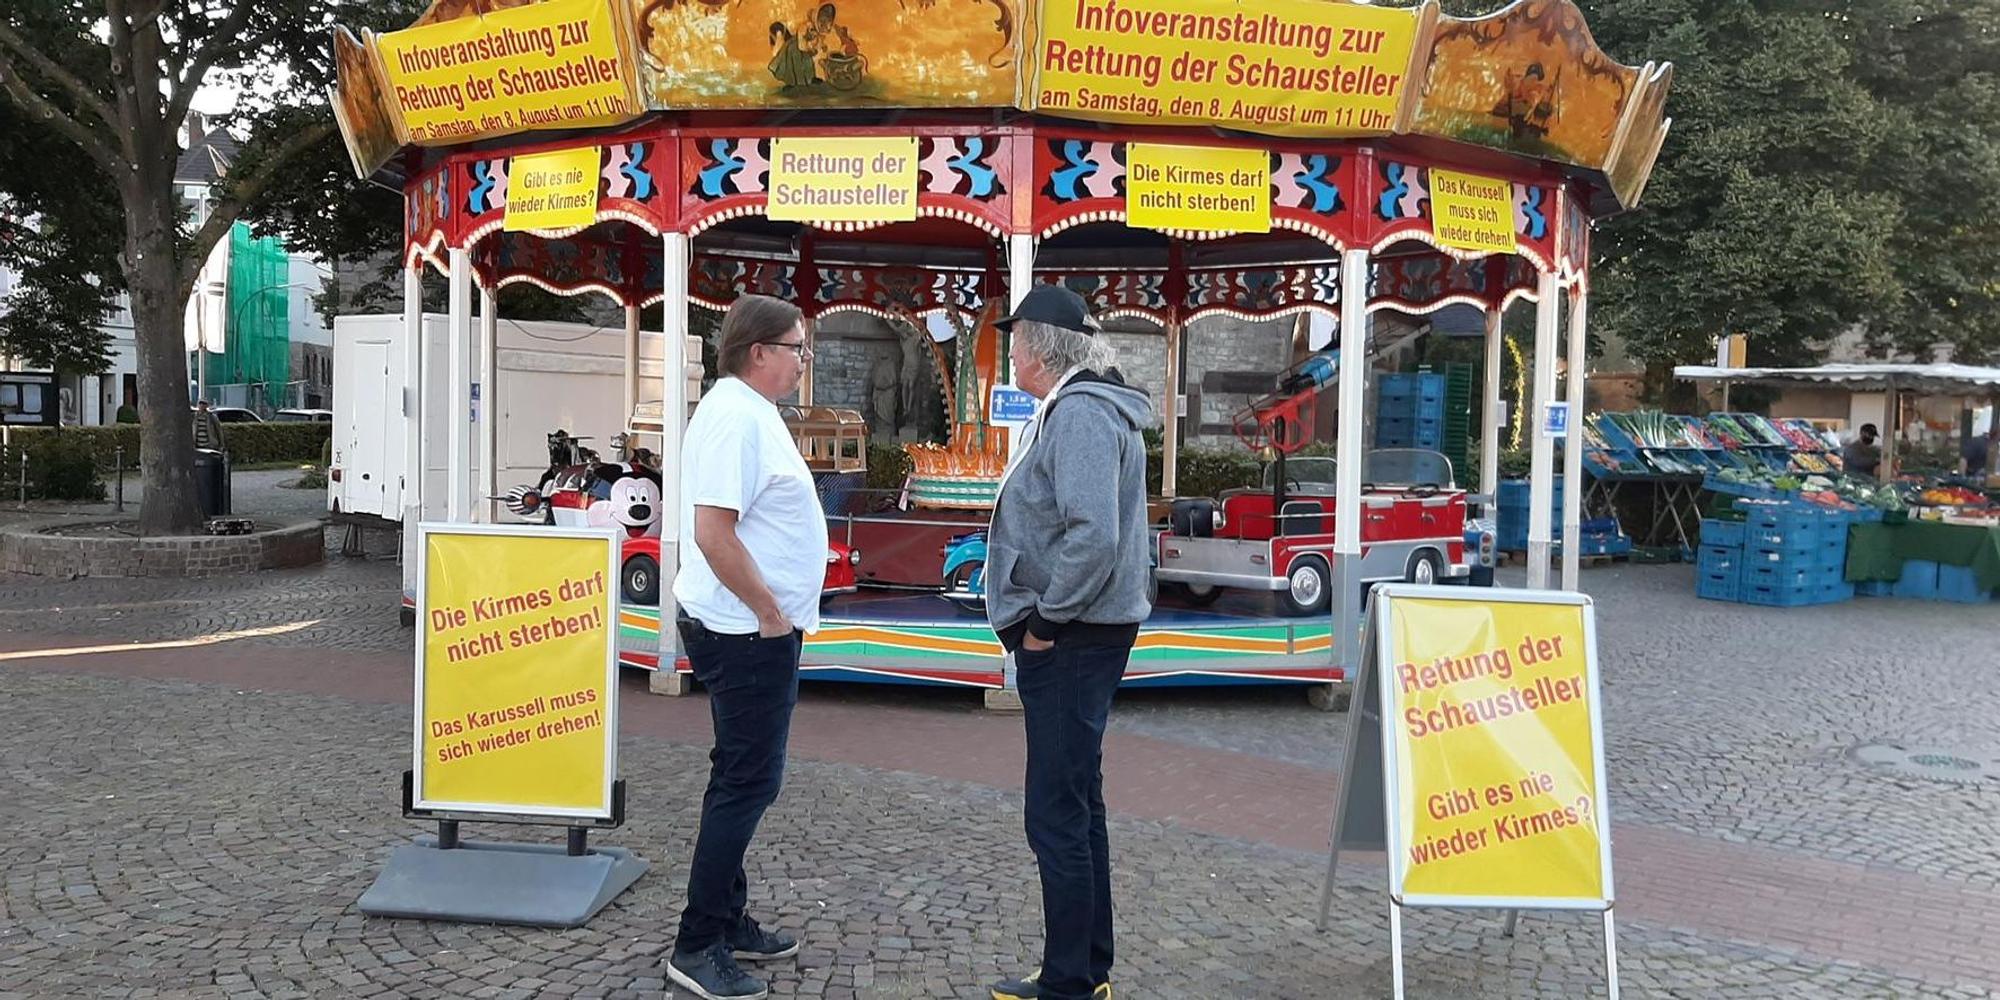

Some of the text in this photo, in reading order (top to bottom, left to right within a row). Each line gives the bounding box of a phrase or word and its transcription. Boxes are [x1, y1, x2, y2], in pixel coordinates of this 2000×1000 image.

[397, 19, 590, 74] Infoveranstaltung zur
[1075, 0, 1386, 58] Infoveranstaltung zur
[397, 56, 619, 112] Rettung der Schausteller
[1044, 40, 1401, 97] Rettung der Schausteller
[410, 127, 427, 140] am
[481, 113, 502, 130] den
[504, 112, 519, 127] 8.
[520, 107, 562, 124] August
[564, 105, 585, 118] um
[587, 98, 602, 116] 11
[1041, 88, 1392, 129] am Samstag, den 8. August um 11 Uhr
[524, 167, 583, 188] Gibt es nie
[782, 152, 906, 178] Rettung der
[1133, 164, 1263, 187] Die Kirmes darf
[1437, 176, 1505, 201] Das Karussell
[509, 190, 594, 213] wieder Kirmes?
[776, 184, 909, 205] Schausteller
[1140, 191, 1255, 212] nicht sterben!
[1449, 205, 1498, 223] muss sich
[1440, 224, 1511, 247] wieder drehen!
[431, 571, 604, 632] Die Kirmes darf
[447, 606, 602, 663] nicht sterben!
[1396, 635, 1563, 694] Rettung der
[431, 688, 597, 739] Das Karussell muss
[1404, 675, 1583, 738] Schausteller
[438, 709, 602, 762] sich wieder drehen!
[1427, 771, 1554, 822] Gibt es nie
[1408, 795, 1593, 866] wieder Kirmes?
